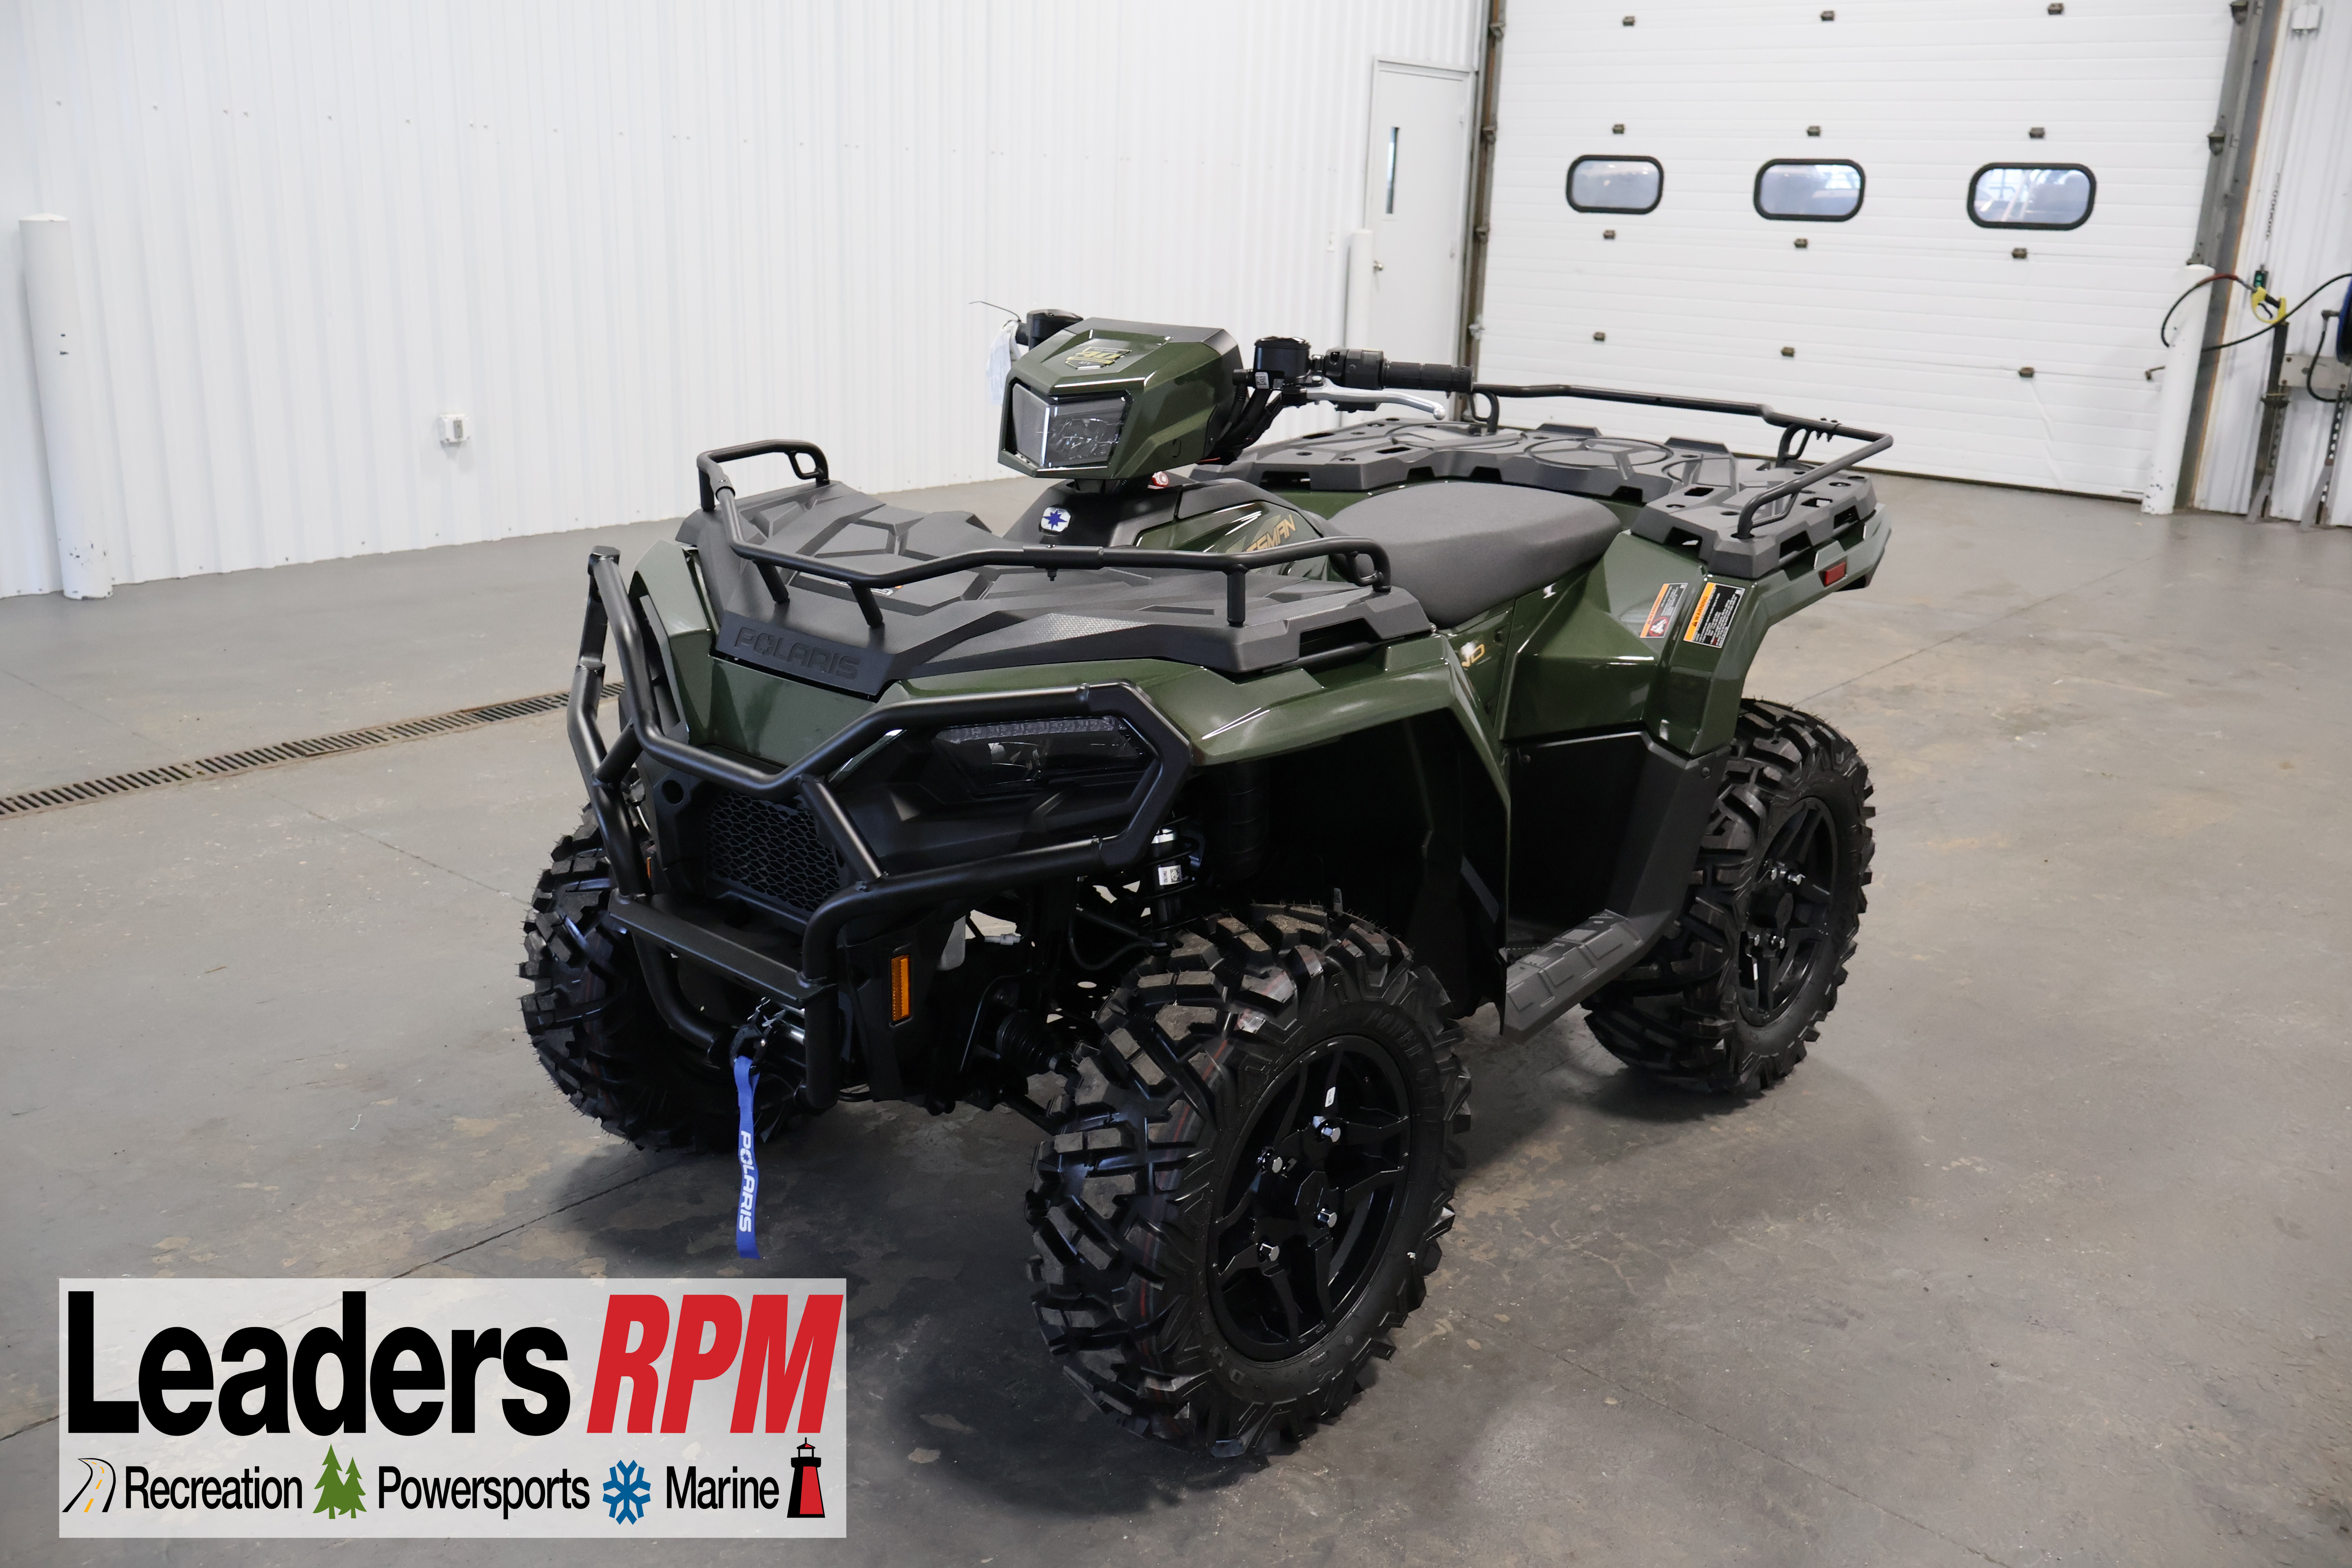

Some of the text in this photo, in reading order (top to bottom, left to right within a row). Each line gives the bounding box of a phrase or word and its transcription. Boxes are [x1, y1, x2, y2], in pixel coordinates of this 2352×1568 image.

[1694, 596, 1708, 620] WARNING
[734, 627, 860, 679] POLARIS
[739, 1130, 755, 1233] POLARIS
